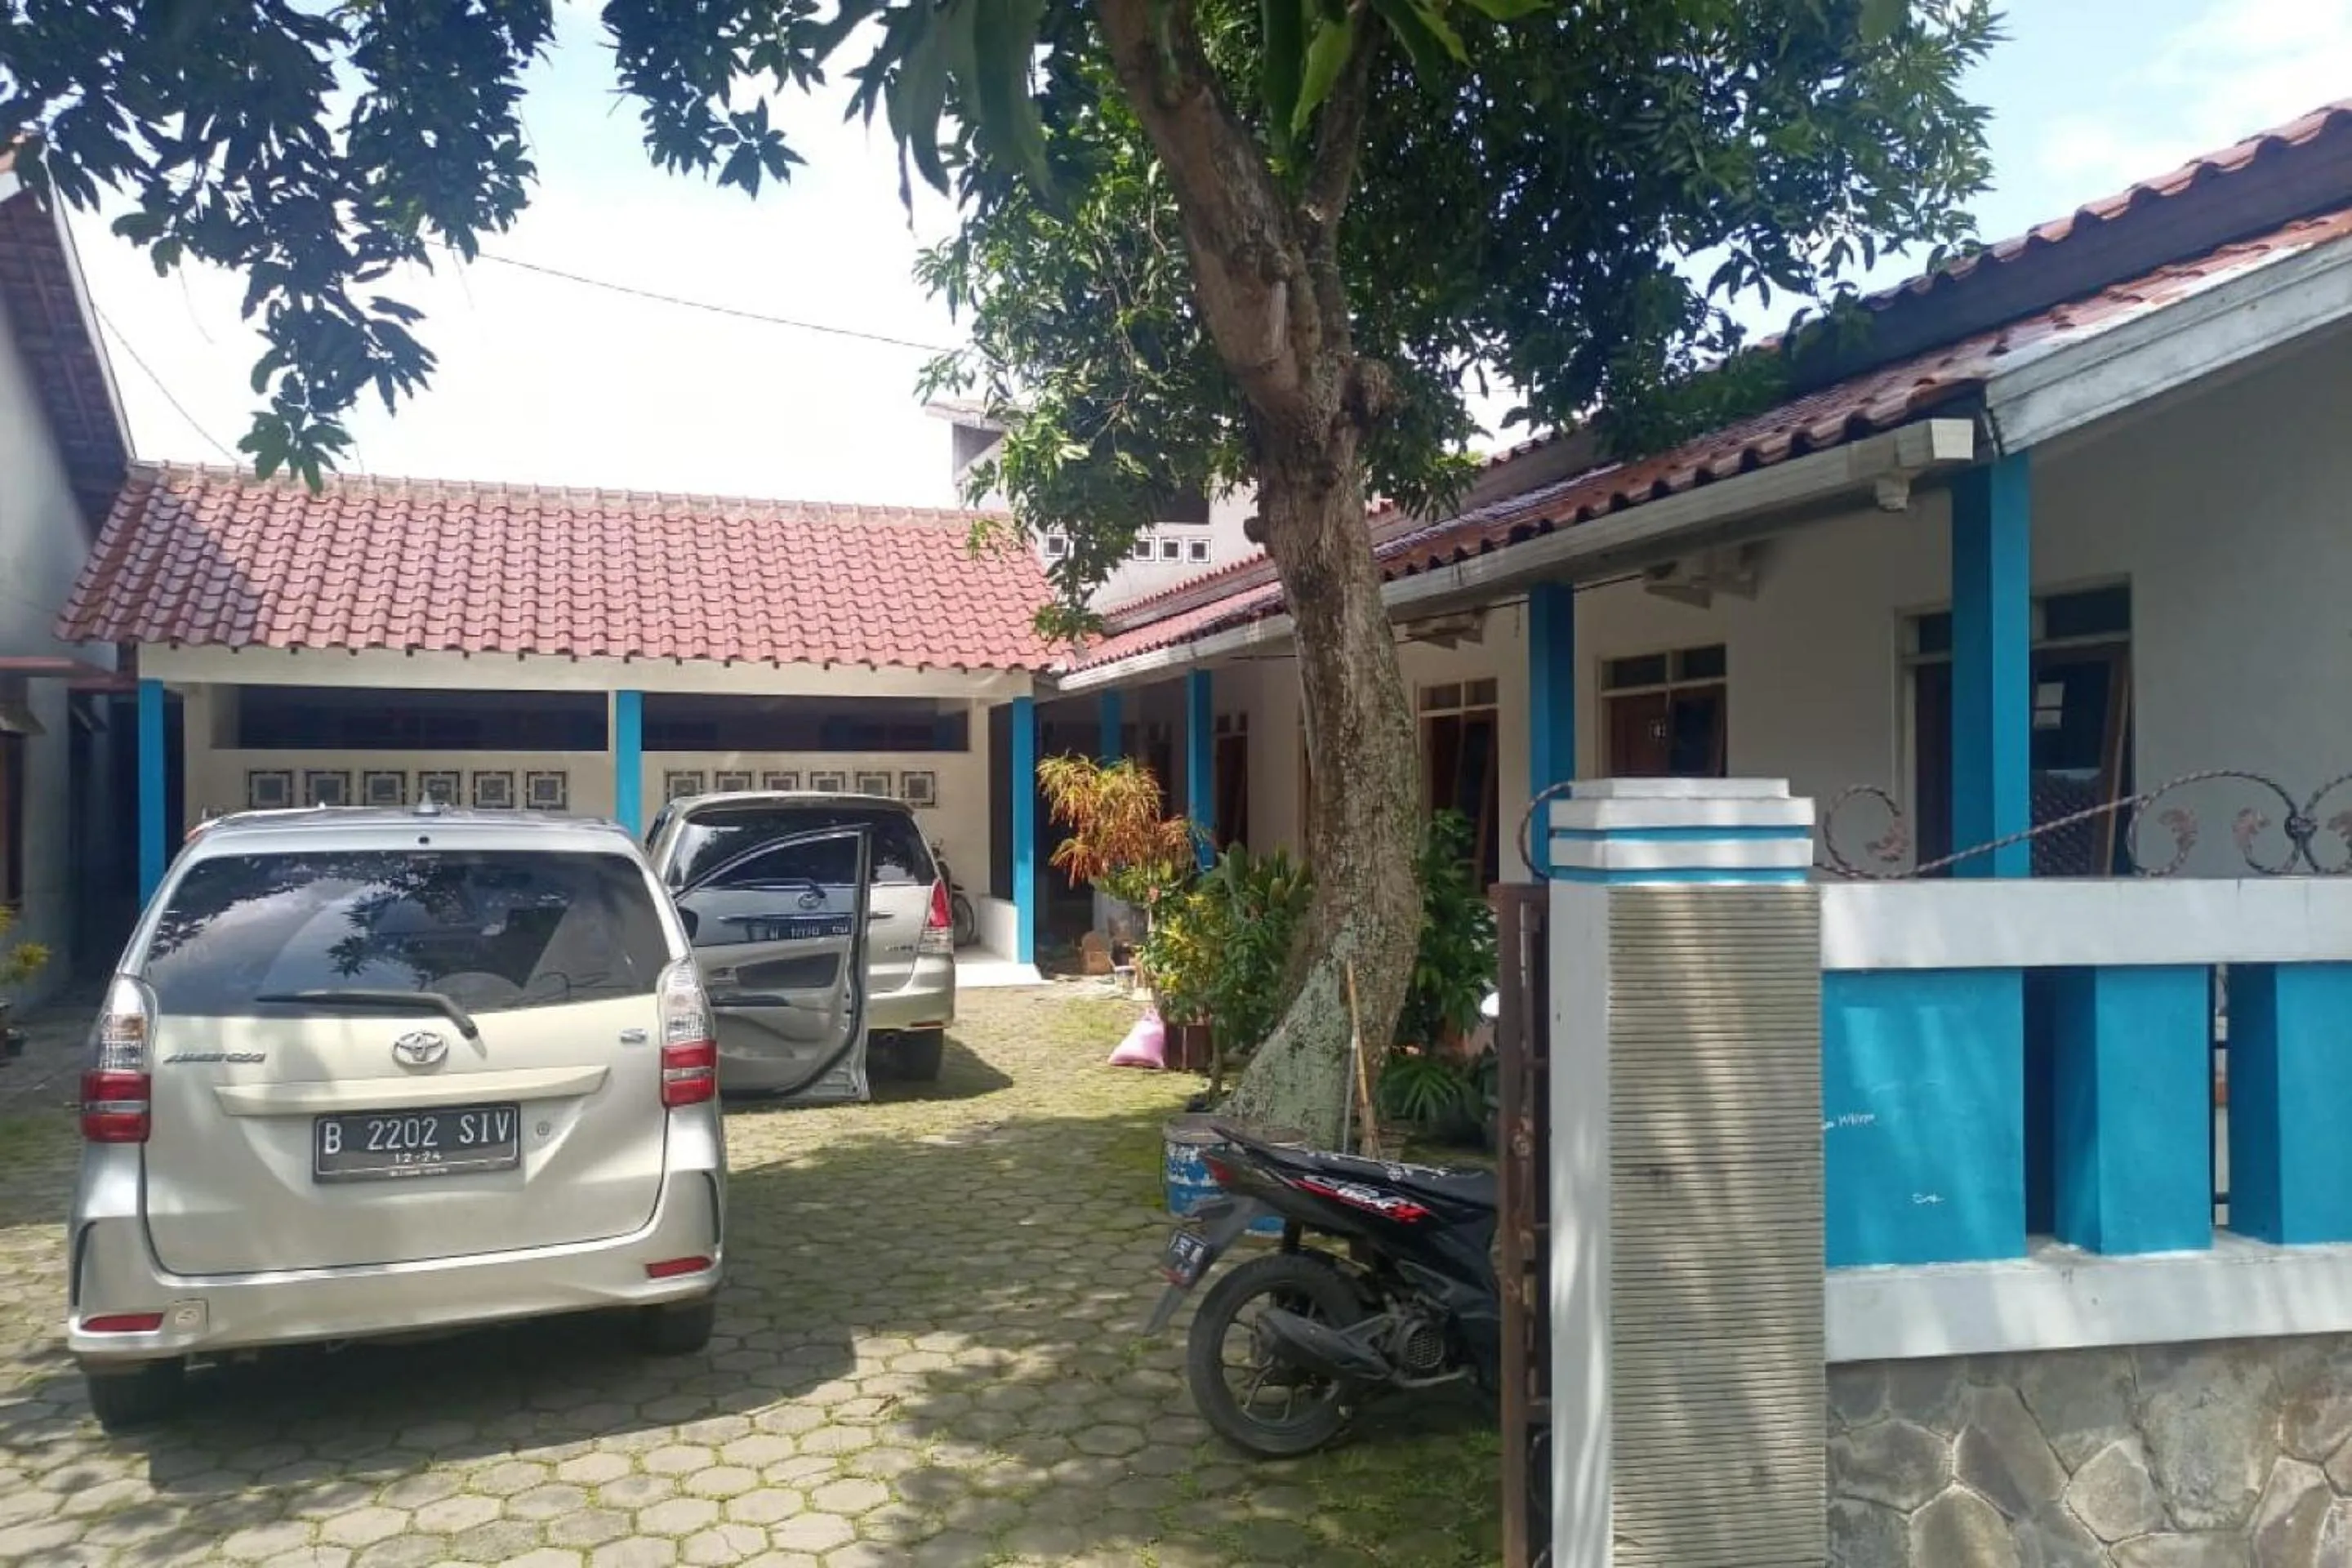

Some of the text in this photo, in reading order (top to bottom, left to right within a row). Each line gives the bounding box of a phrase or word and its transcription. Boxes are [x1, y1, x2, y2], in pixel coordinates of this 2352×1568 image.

[324, 1111, 510, 1155] B 2202 SIV
